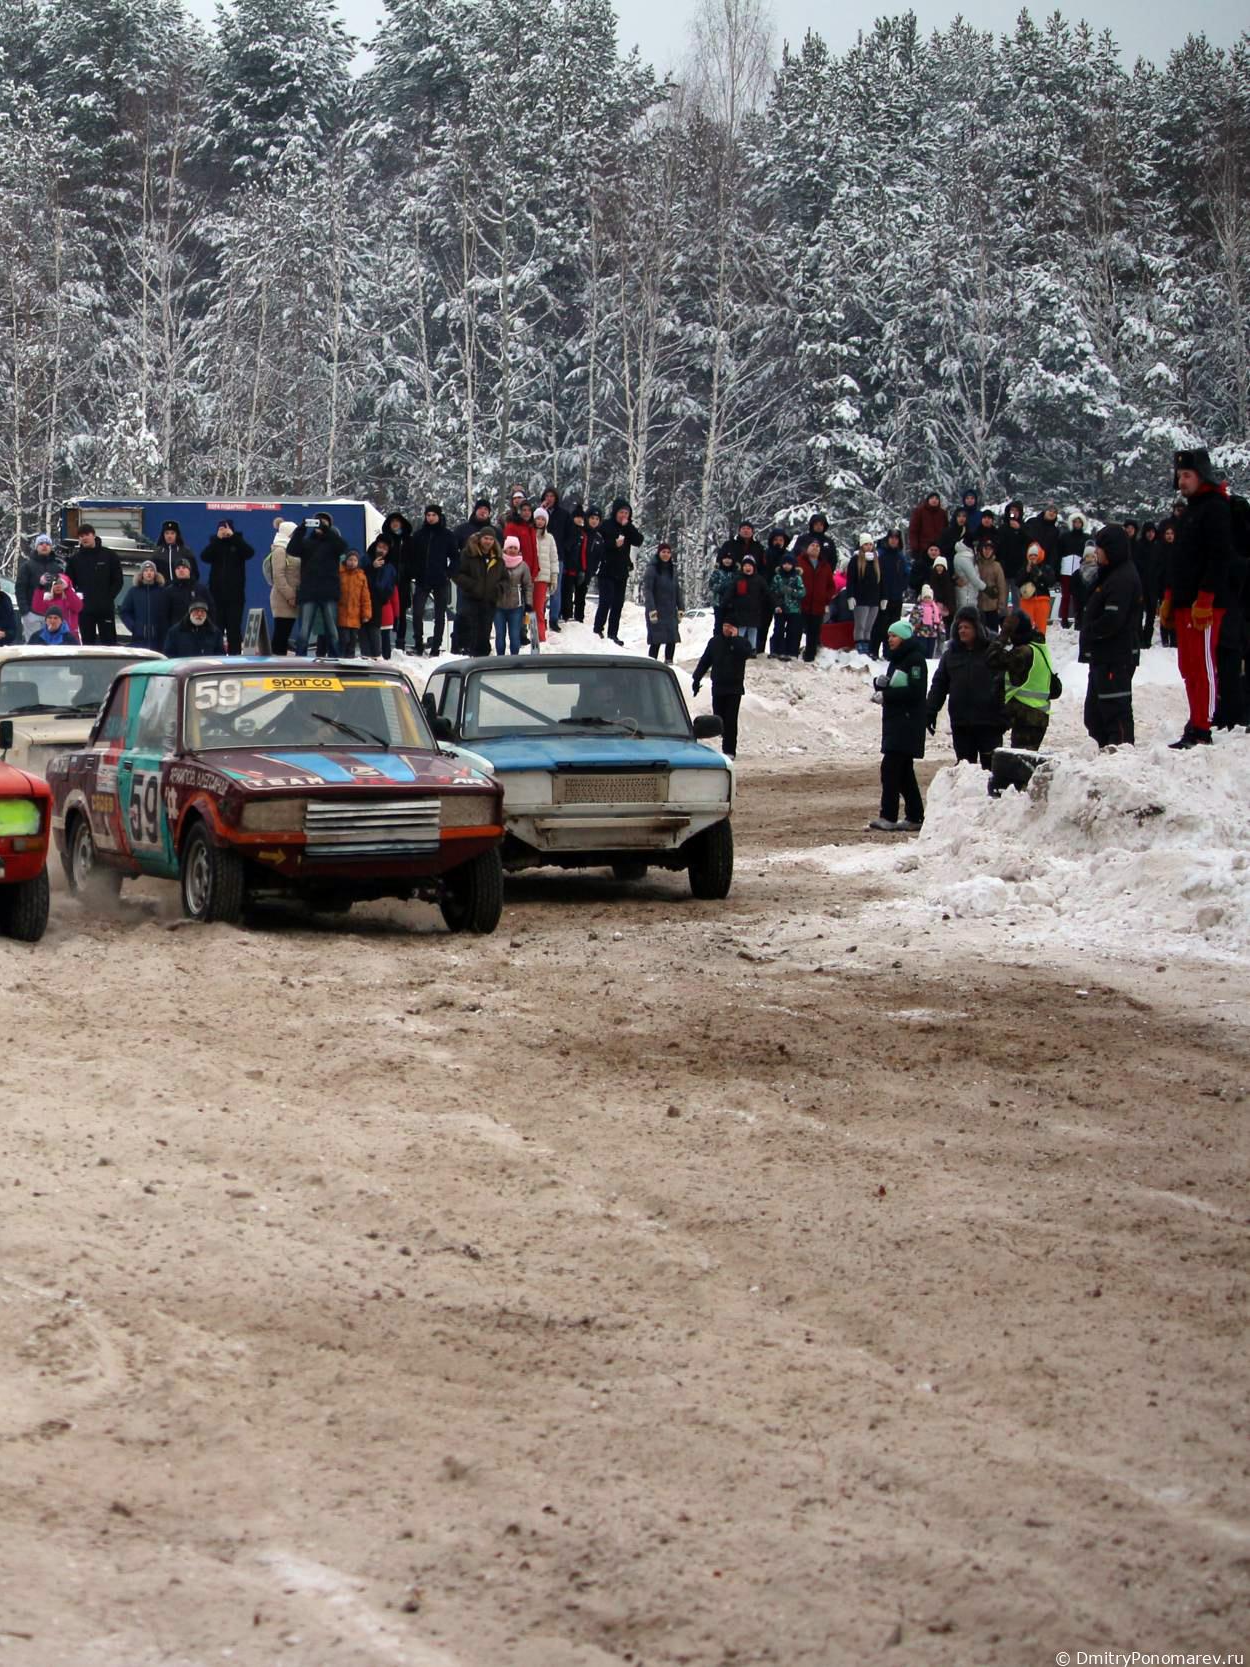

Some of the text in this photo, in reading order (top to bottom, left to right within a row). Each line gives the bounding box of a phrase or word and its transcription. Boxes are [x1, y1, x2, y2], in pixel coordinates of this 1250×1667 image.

[271, 678, 332, 689] sparco
[195, 679, 241, 709] 59
[247, 777, 325, 787] TEAM
[130, 774, 158, 843] 59
